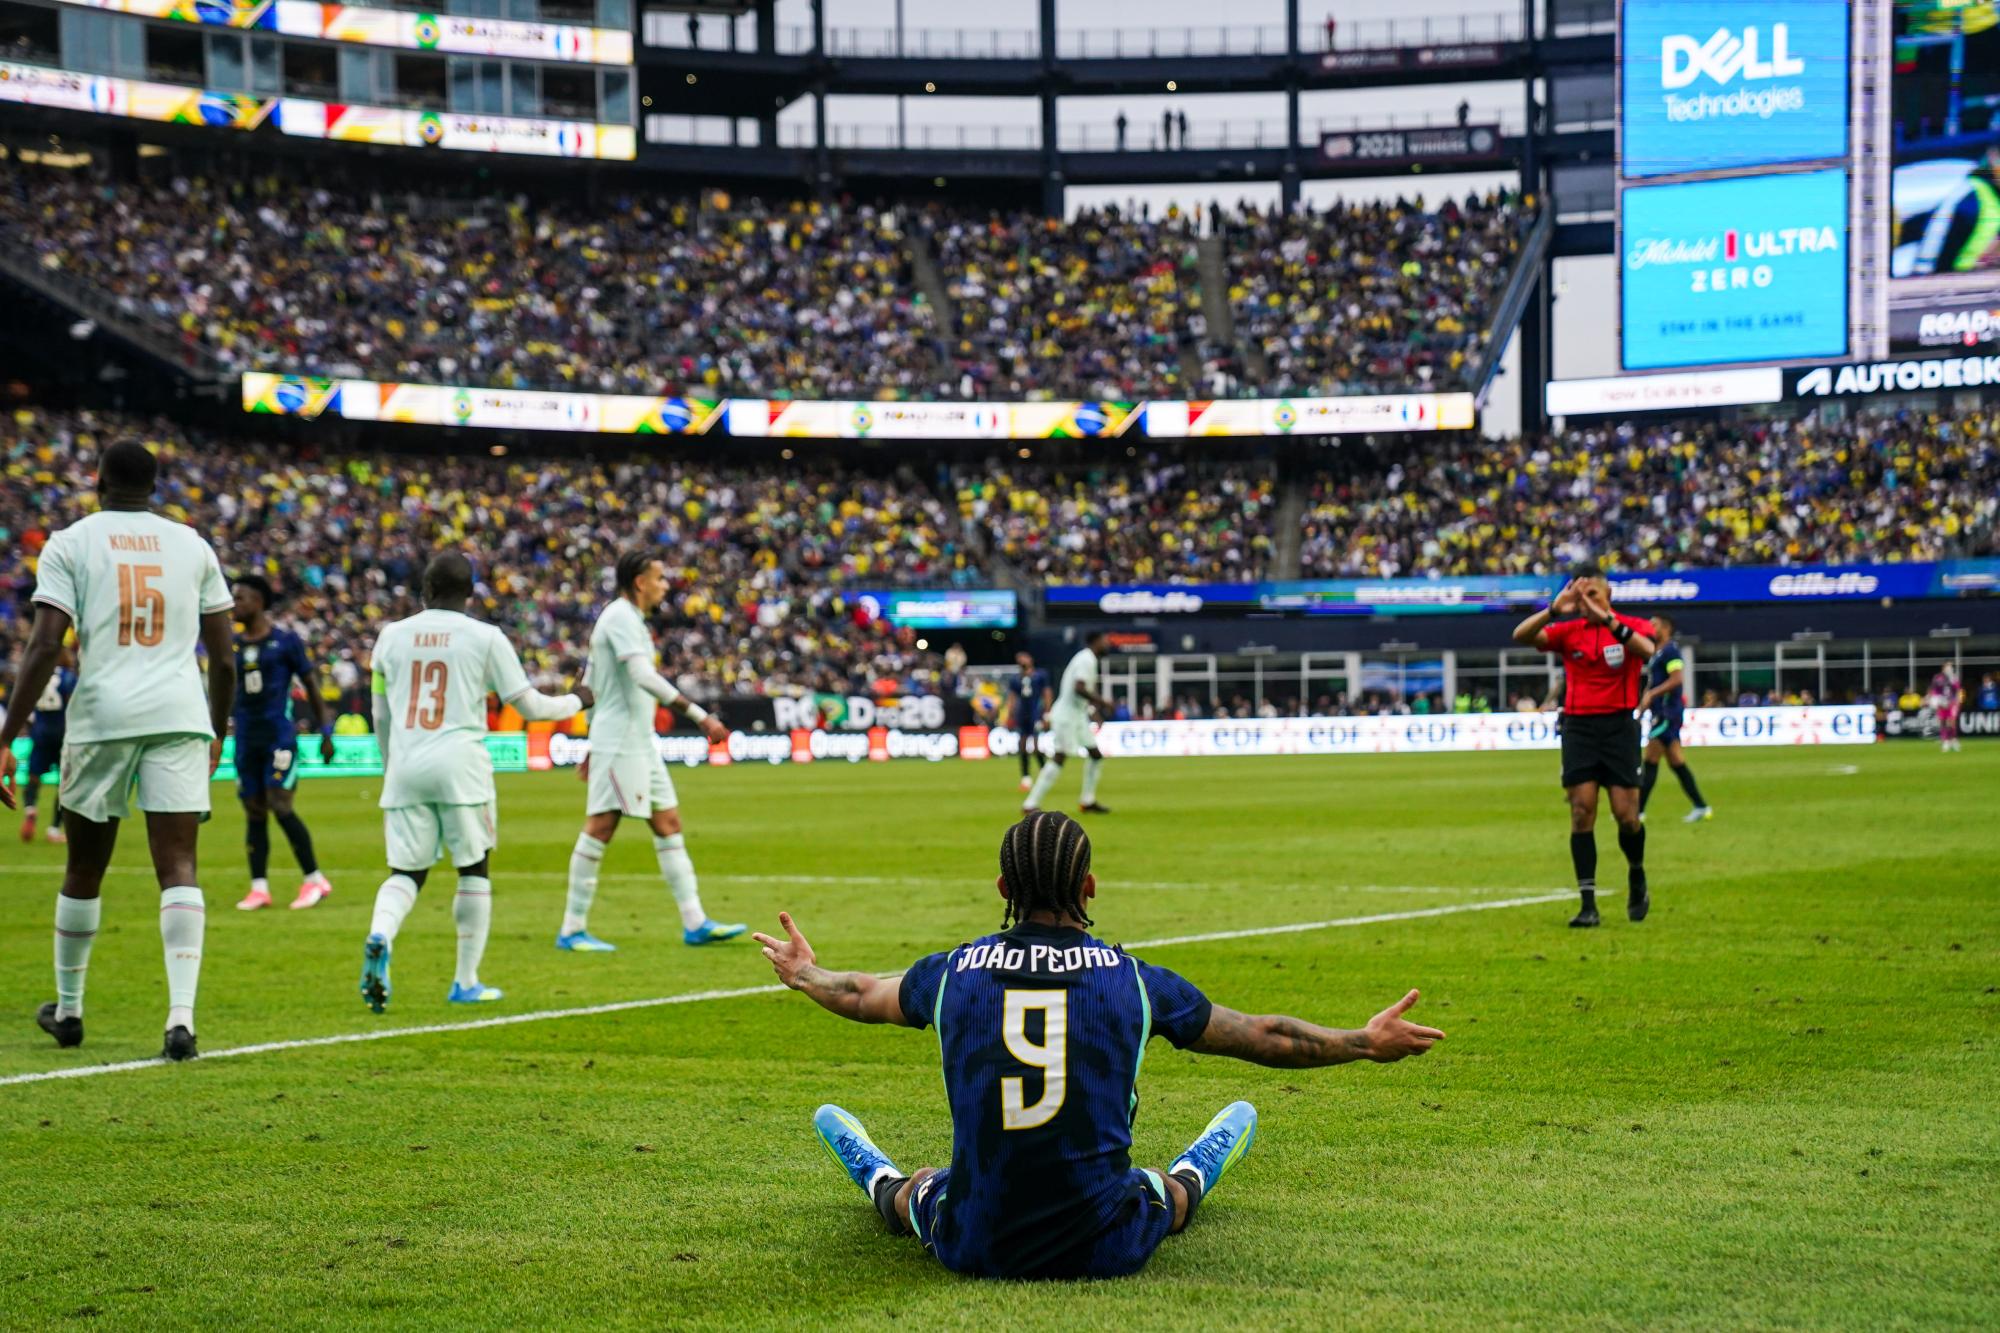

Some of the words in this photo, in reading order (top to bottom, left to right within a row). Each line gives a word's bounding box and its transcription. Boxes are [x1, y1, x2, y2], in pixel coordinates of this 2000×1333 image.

[1661, 23, 1805, 88] DELL
[1662, 86, 1805, 121] Technologies
[1355, 134, 1404, 158] 2021
[1744, 226, 1838, 257] ULTRA
[1691, 265, 1773, 292] ZERO
[1919, 309, 1990, 337] ROAD
[1834, 356, 2000, 394] AUTODESK
[108, 534, 161, 552] KONATE
[1769, 572, 1878, 596] Gillette
[117, 563, 165, 647] 15
[1099, 591, 1203, 614] Gillette
[413, 632, 451, 648] KANTE
[405, 660, 448, 731] 13
[886, 728, 958, 762] Orange
[956, 941, 1025, 973] JOÃO
[1030, 944, 1120, 973] PEDRO
[1001, 989, 1068, 1131] 9
